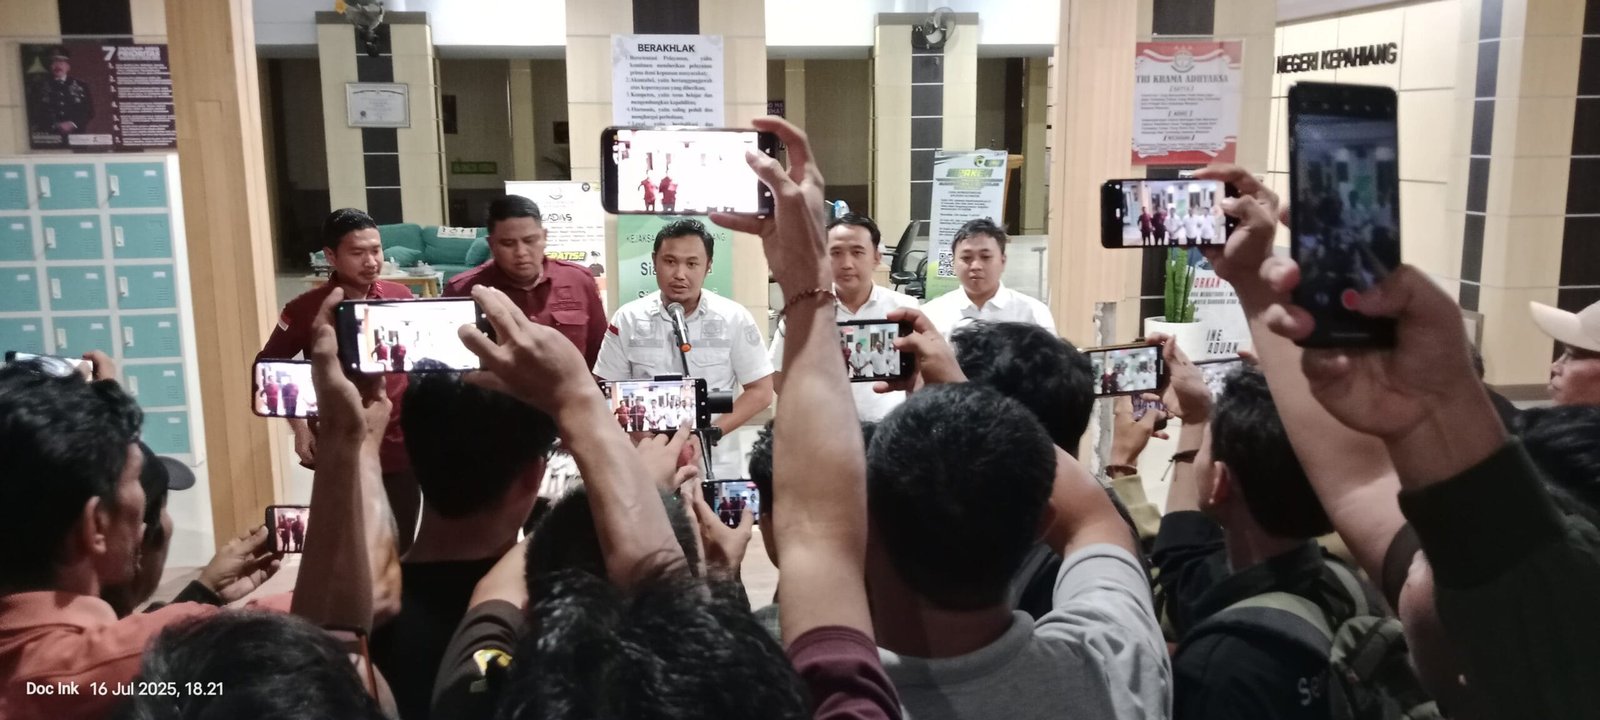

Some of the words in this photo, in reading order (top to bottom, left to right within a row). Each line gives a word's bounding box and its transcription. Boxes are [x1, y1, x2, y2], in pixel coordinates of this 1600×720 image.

[102, 46, 116, 61] 7
[638, 44, 695, 52] BERAKHLAK
[1276, 51, 1319, 74] NEGERI
[1320, 42, 1398, 70] KEPAHIANG
[1153, 74, 1182, 83] KRAMA
